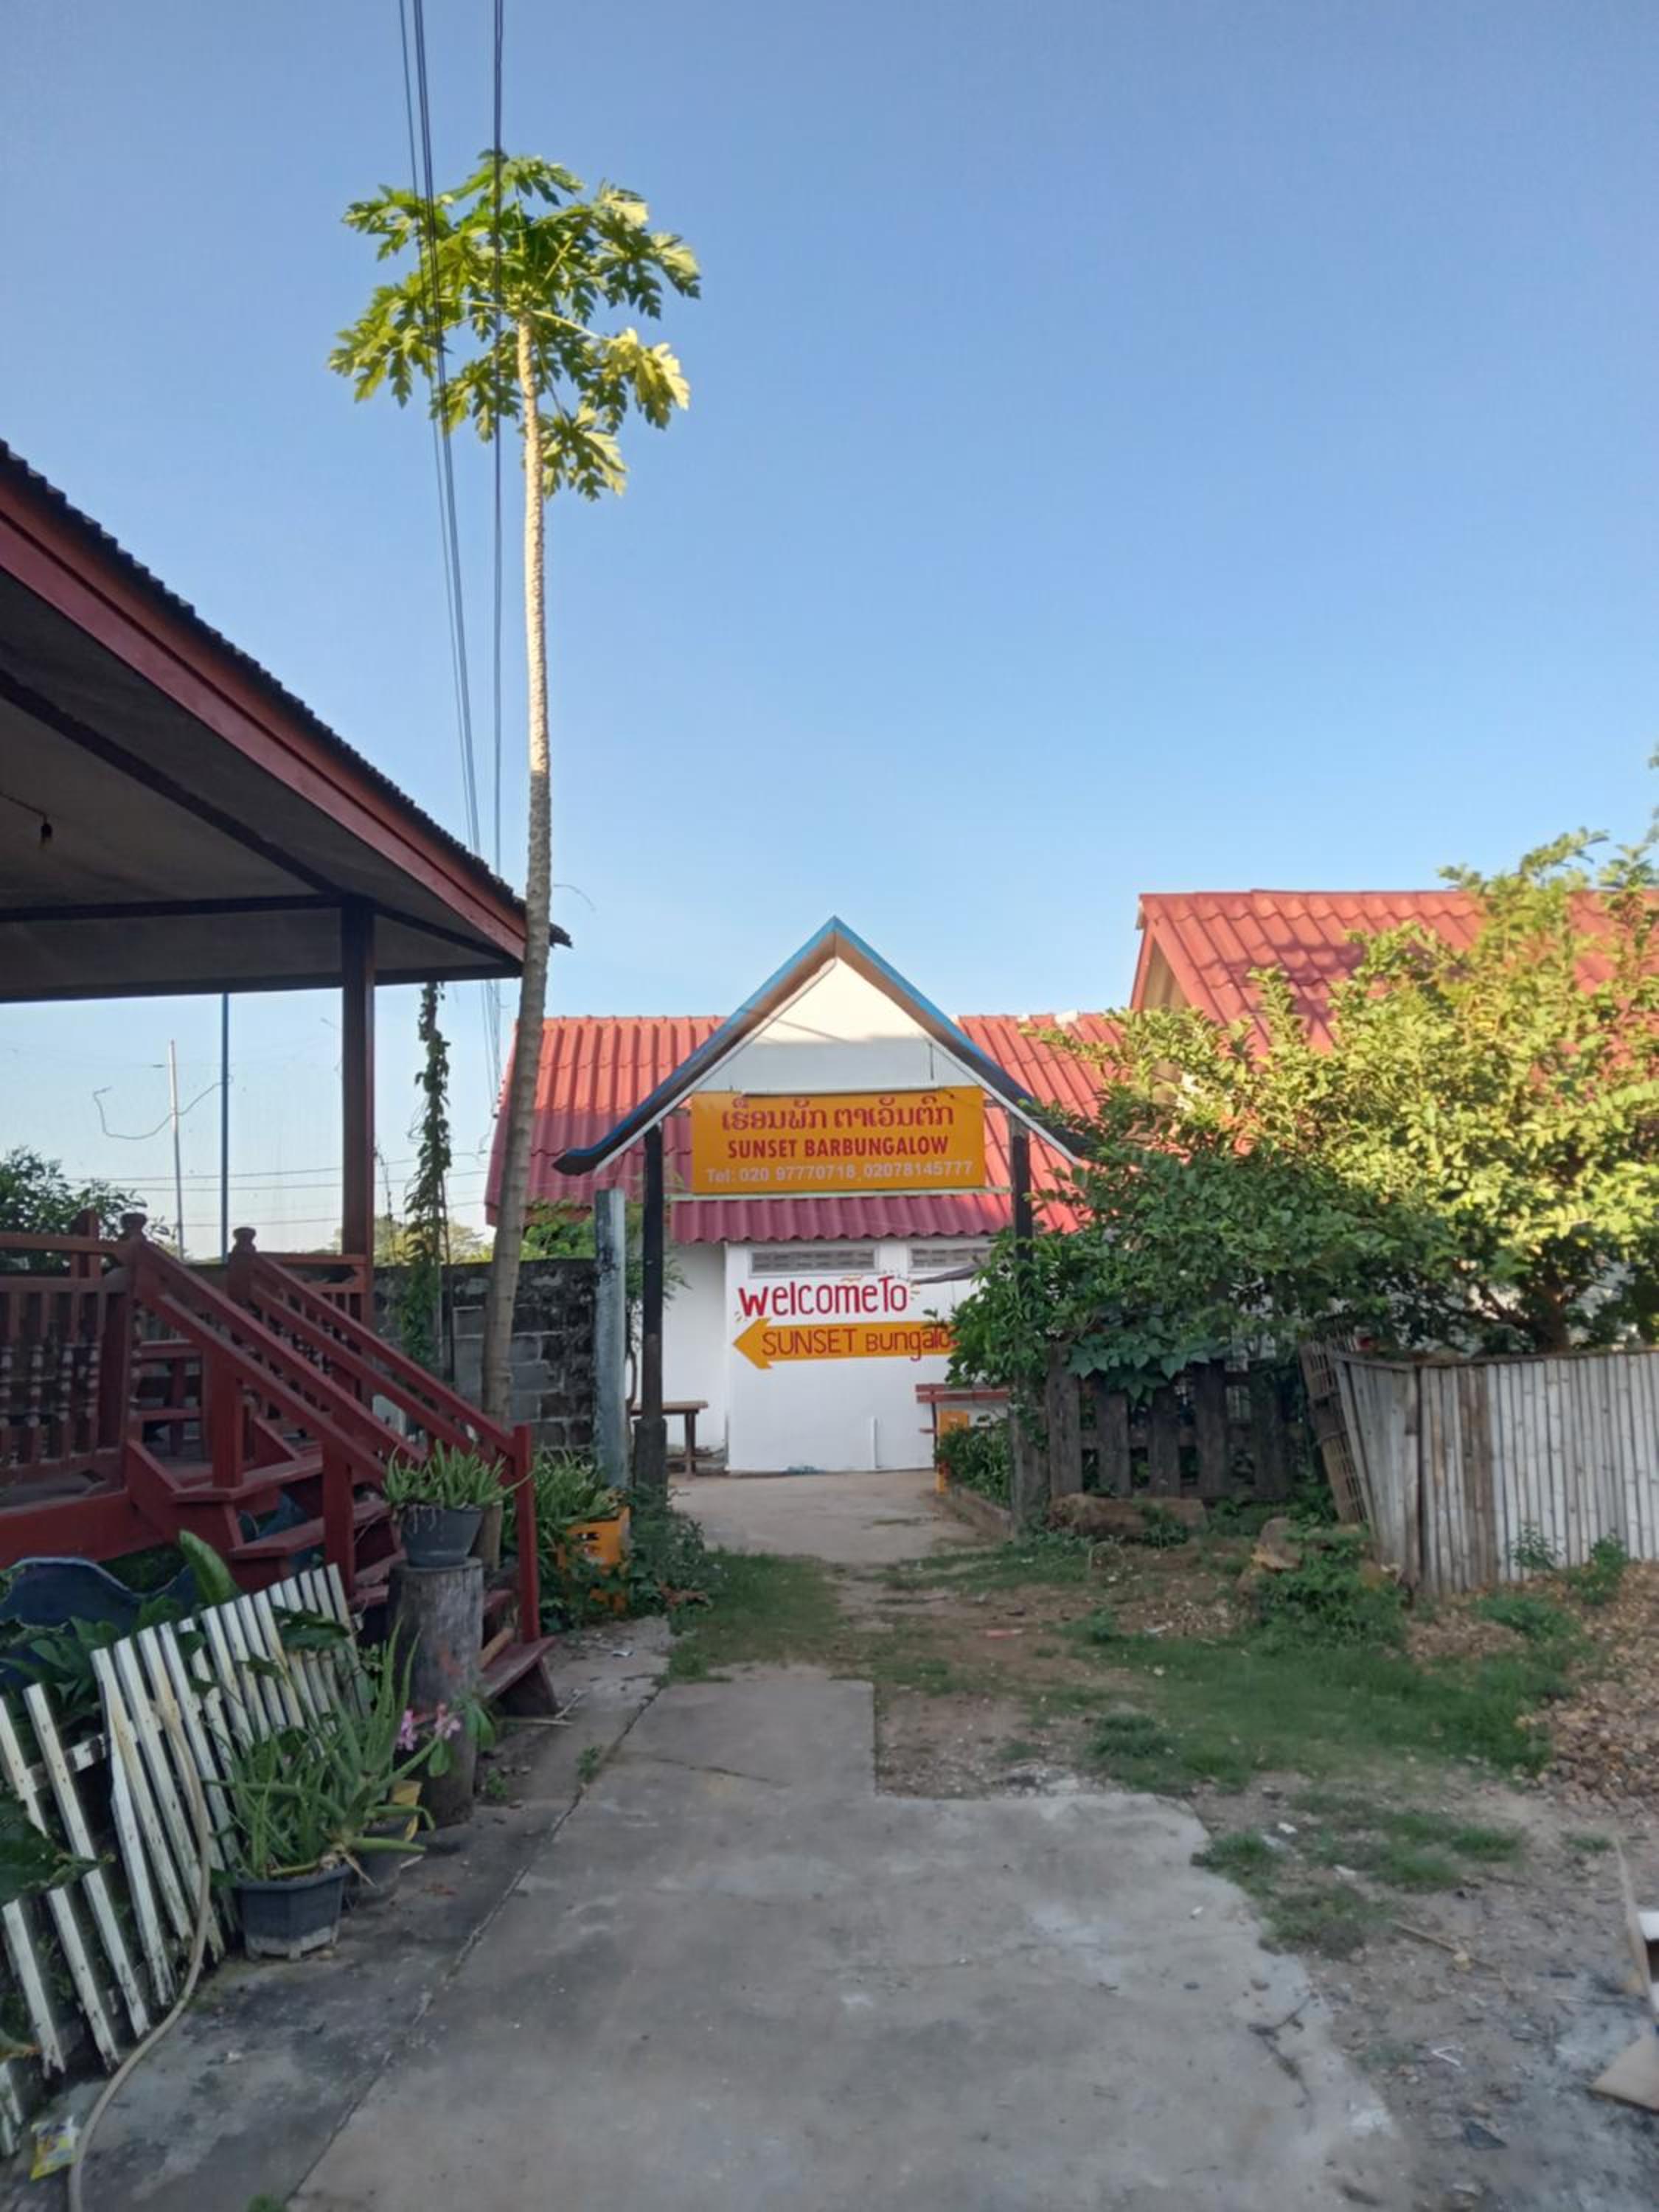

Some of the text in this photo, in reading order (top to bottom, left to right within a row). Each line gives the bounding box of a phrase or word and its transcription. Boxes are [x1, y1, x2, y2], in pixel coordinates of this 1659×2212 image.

[728, 1135, 949, 1159] SUNSET BARBUNGALOW
[740, 1166, 769, 1182] 020
[762, 1328, 858, 1357] SUNSET
